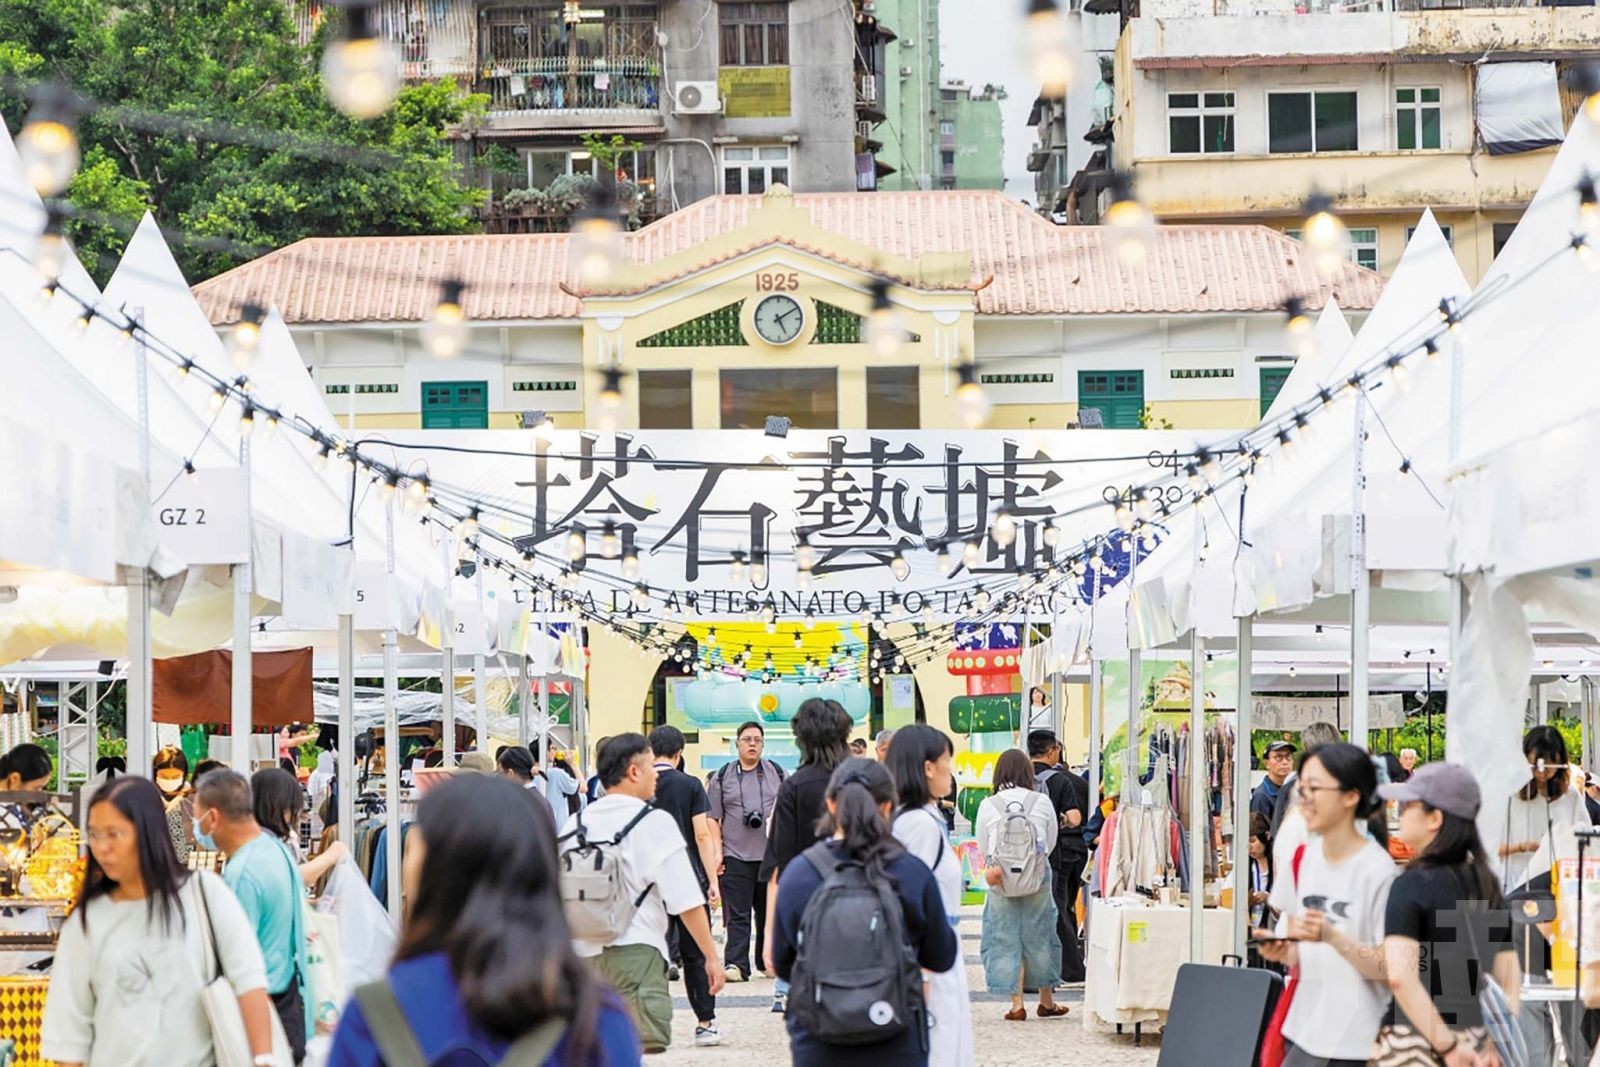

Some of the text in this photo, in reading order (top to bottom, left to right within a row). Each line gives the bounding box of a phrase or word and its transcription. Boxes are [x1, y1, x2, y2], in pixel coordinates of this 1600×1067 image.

[756, 273, 799, 291] 1925
[1147, 449, 1183, 477] 04
[160, 508, 206, 526] GZ 2
[513, 430, 1064, 588] 塔石藝墟
[357, 590, 364, 602] 5
[666, 589, 867, 615] ARTESANATO
